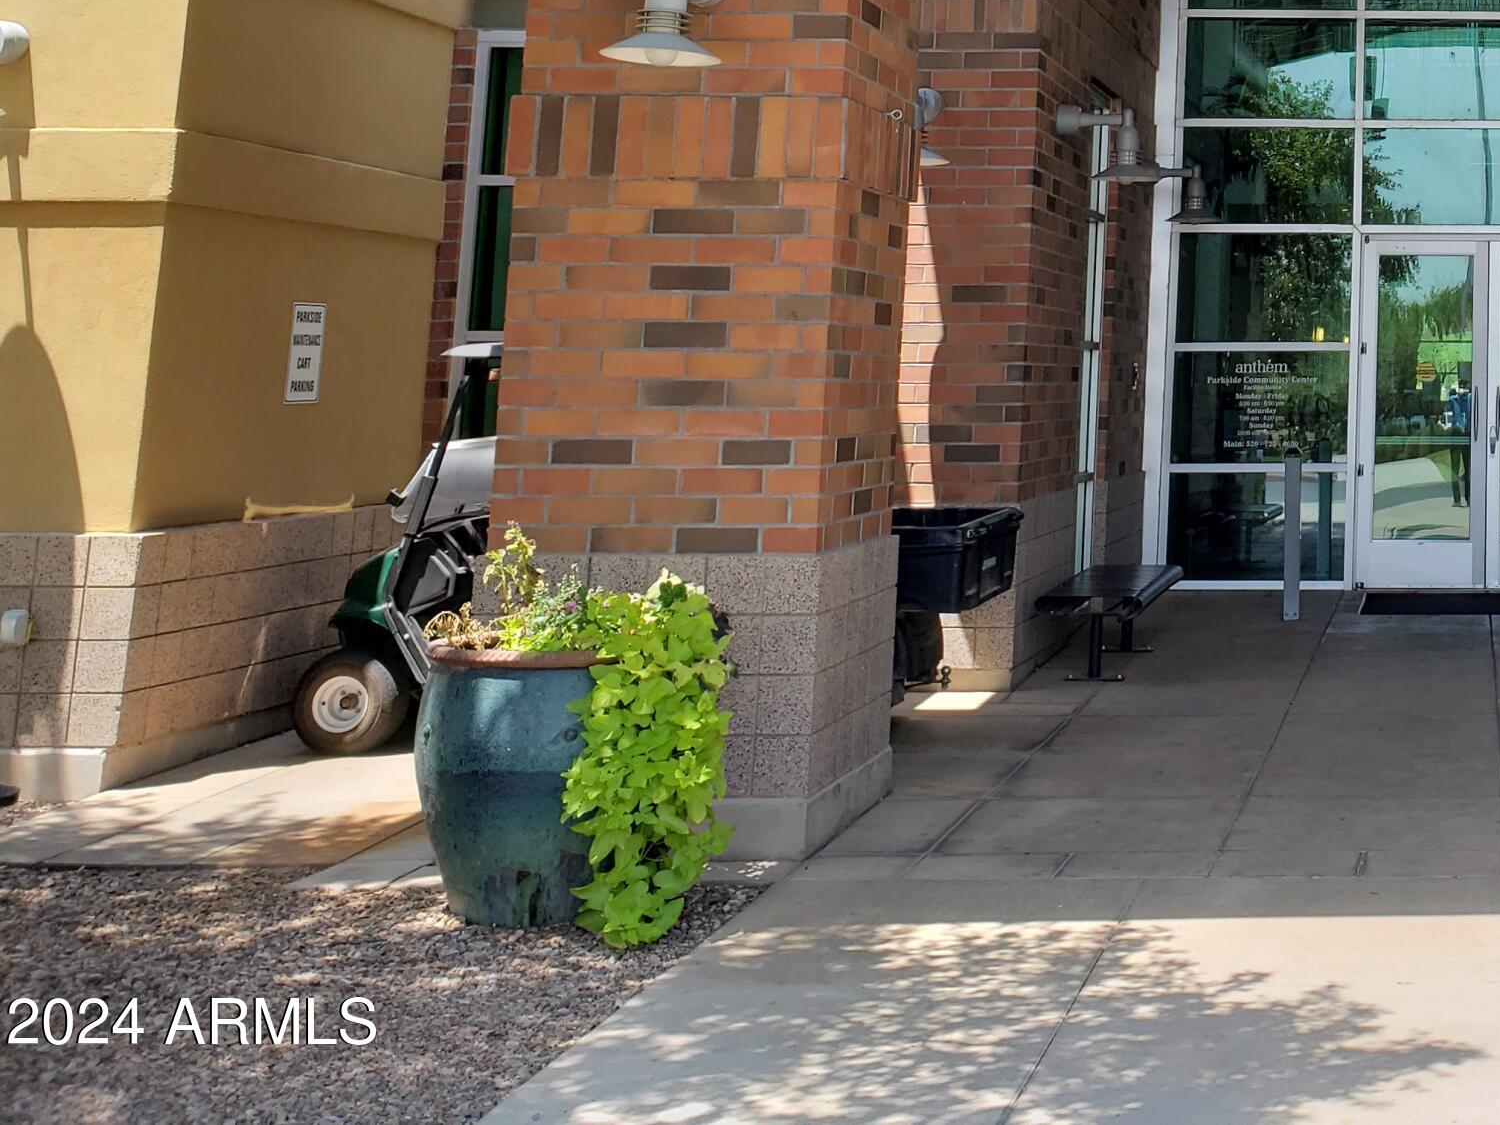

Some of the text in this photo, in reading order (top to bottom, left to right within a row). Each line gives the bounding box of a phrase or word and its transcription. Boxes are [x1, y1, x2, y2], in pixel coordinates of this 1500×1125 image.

[296, 311, 322, 324] PARKSIDE
[293, 334, 321, 346] MAINTENANCE
[297, 357, 312, 369] CART
[1235, 359, 1288, 374] anthem
[290, 380, 315, 392] PARKING
[1207, 376, 1318, 385] Parkside Community Center
[1223, 440, 1245, 448] Main:
